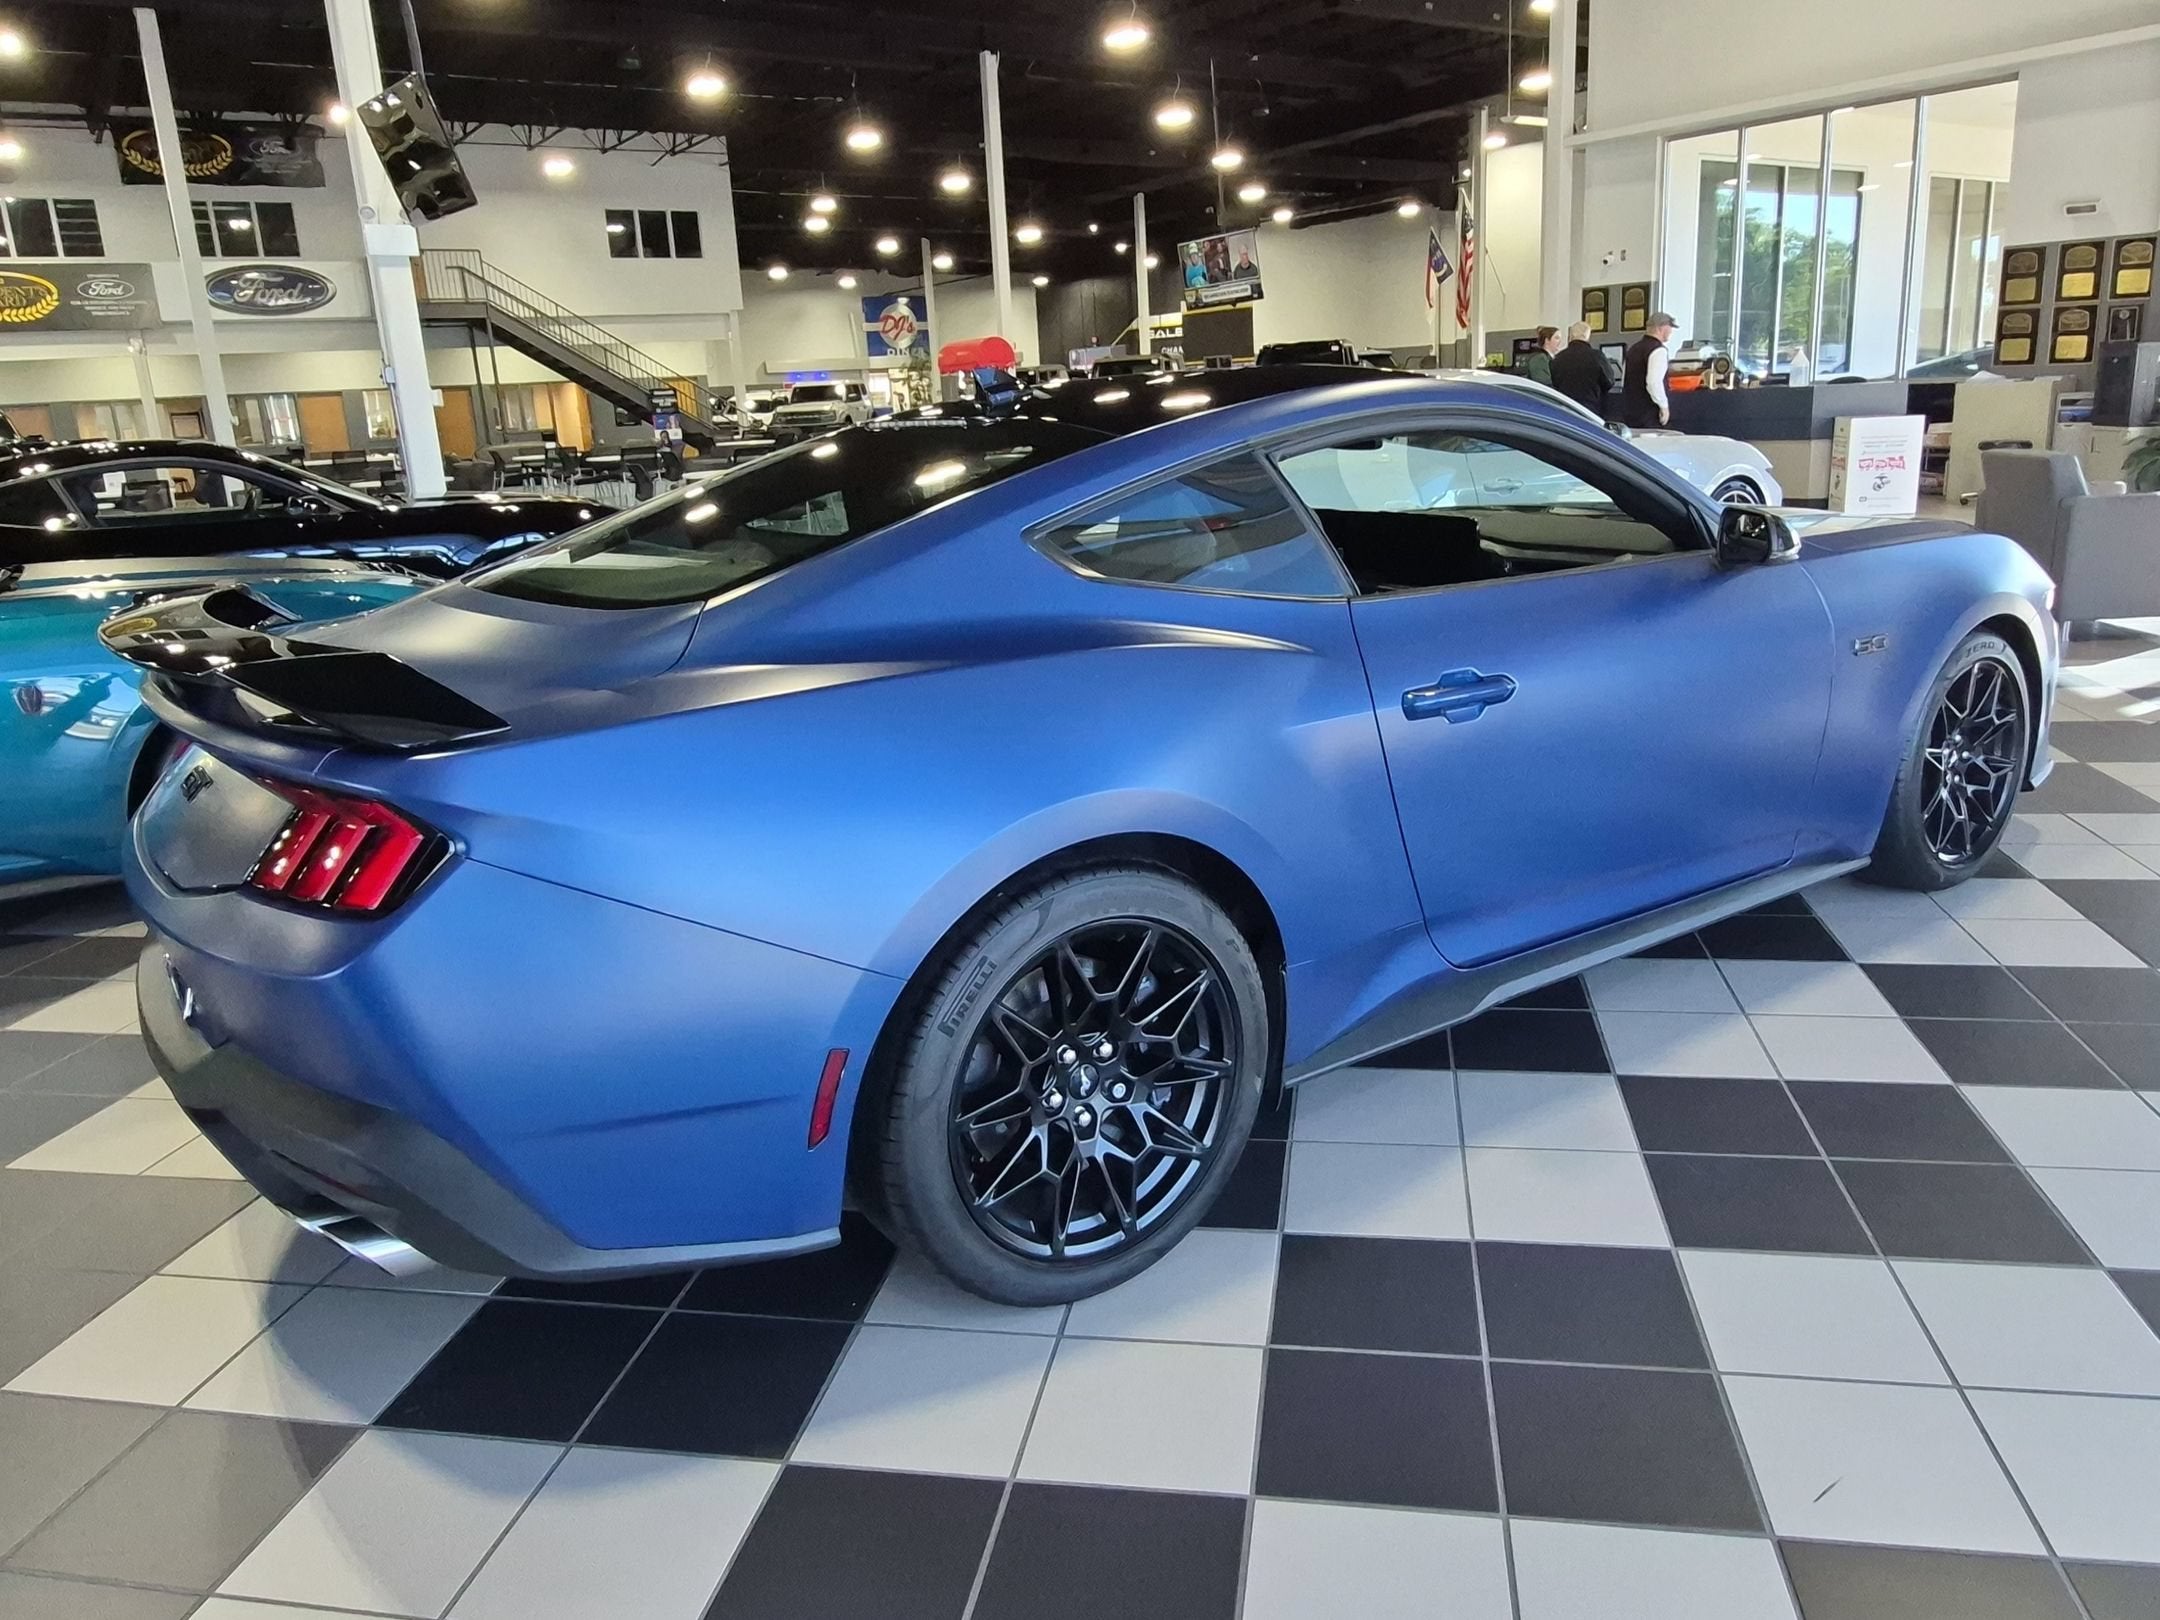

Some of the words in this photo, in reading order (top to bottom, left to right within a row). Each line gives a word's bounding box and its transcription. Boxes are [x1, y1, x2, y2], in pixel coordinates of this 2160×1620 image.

[88, 281, 125, 296] Ford
[233, 271, 312, 306] Ford
[880, 314, 916, 341] DJ's
[1965, 641, 1995, 658] ZERO
[938, 955, 998, 1038] PIRELLI
